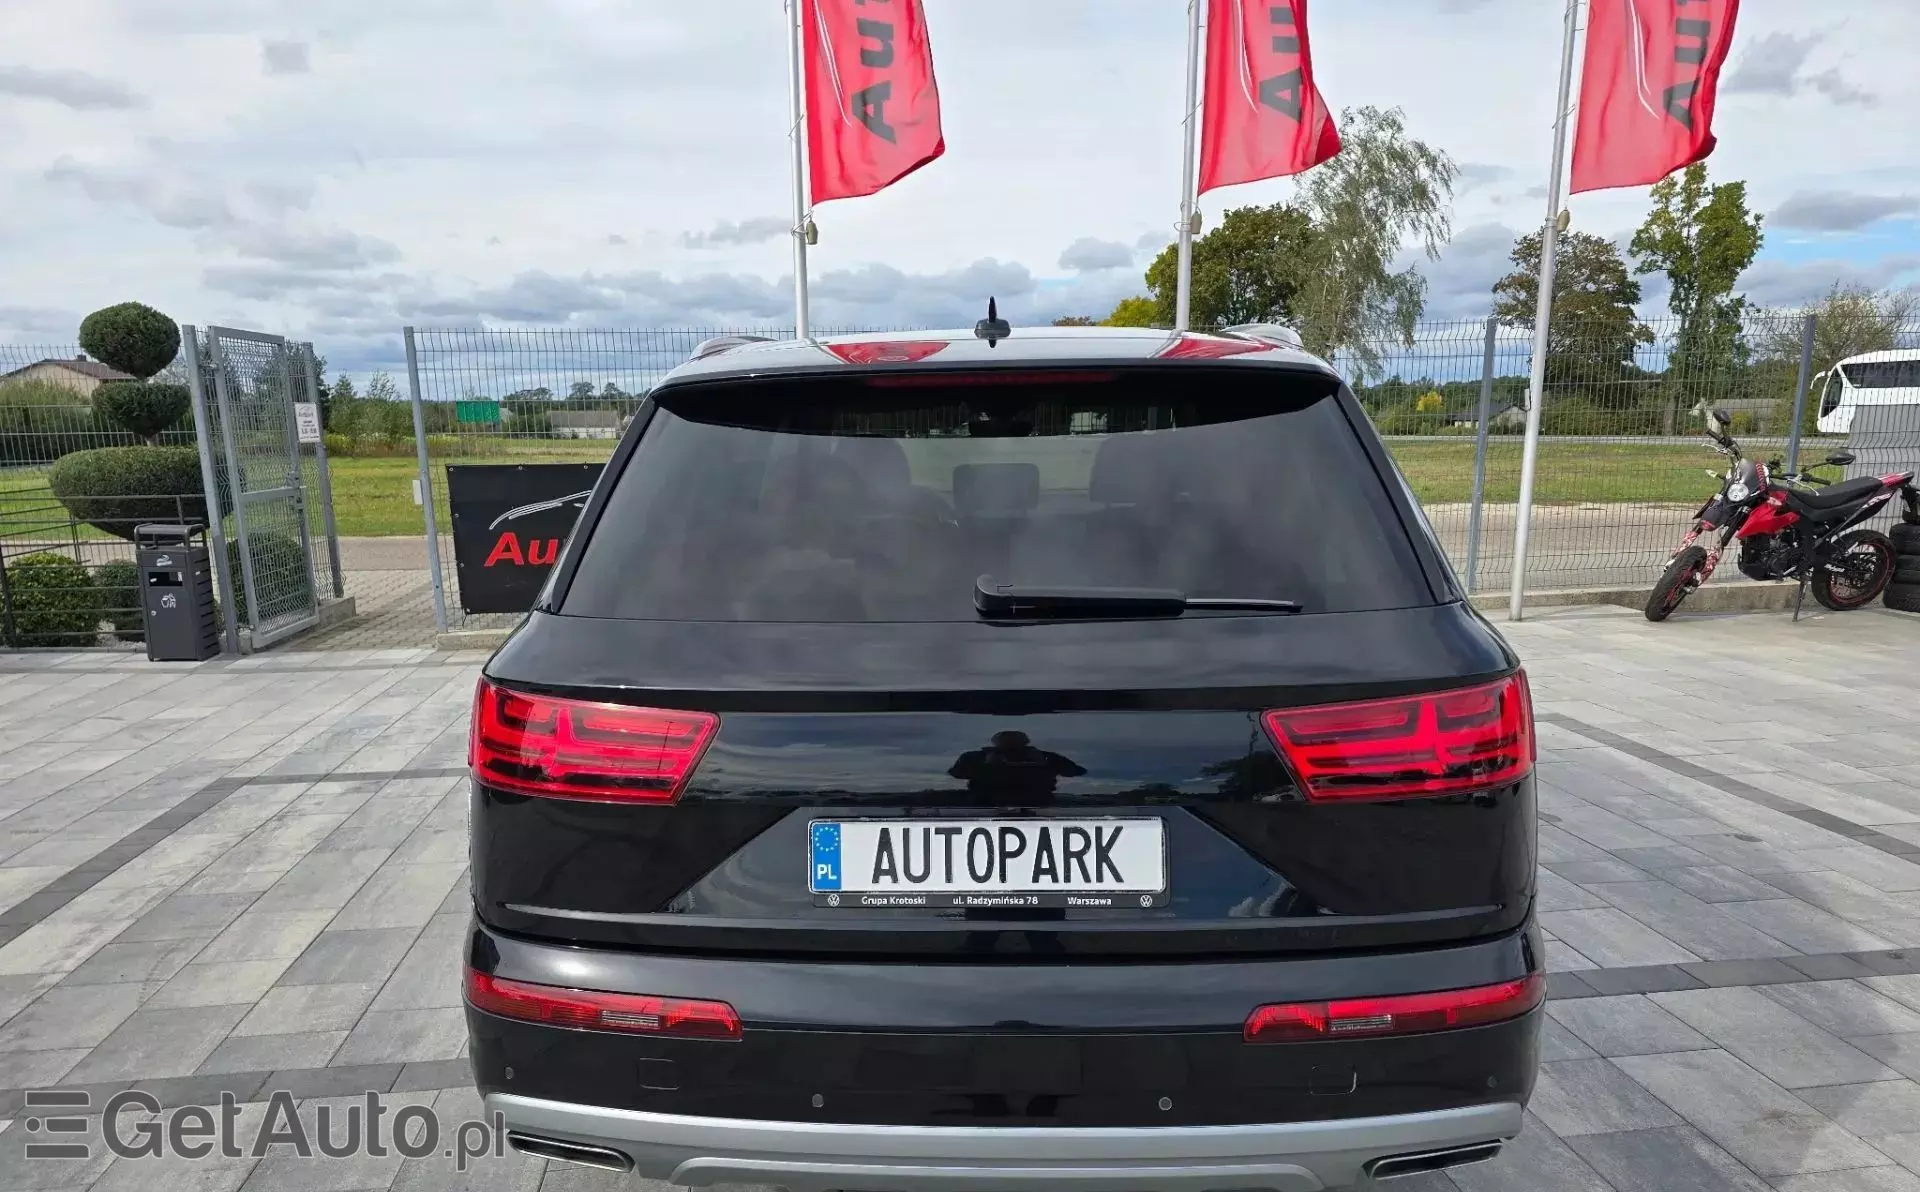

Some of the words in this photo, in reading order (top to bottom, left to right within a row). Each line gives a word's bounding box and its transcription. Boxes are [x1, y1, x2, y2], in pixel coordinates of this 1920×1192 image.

[850, 0, 897, 145] Au
[1662, 0, 1711, 131] Au
[816, 864, 837, 880] PL
[871, 825, 1124, 885] AUTOPARK
[861, 896, 888, 906] Grupa
[889, 896, 926, 905] Krotoski
[952, 896, 964, 905] ul.
[966, 896, 1024, 906] Radzymińska
[1026, 896, 1039, 905] 78
[1067, 896, 1112, 905] Warszawa
